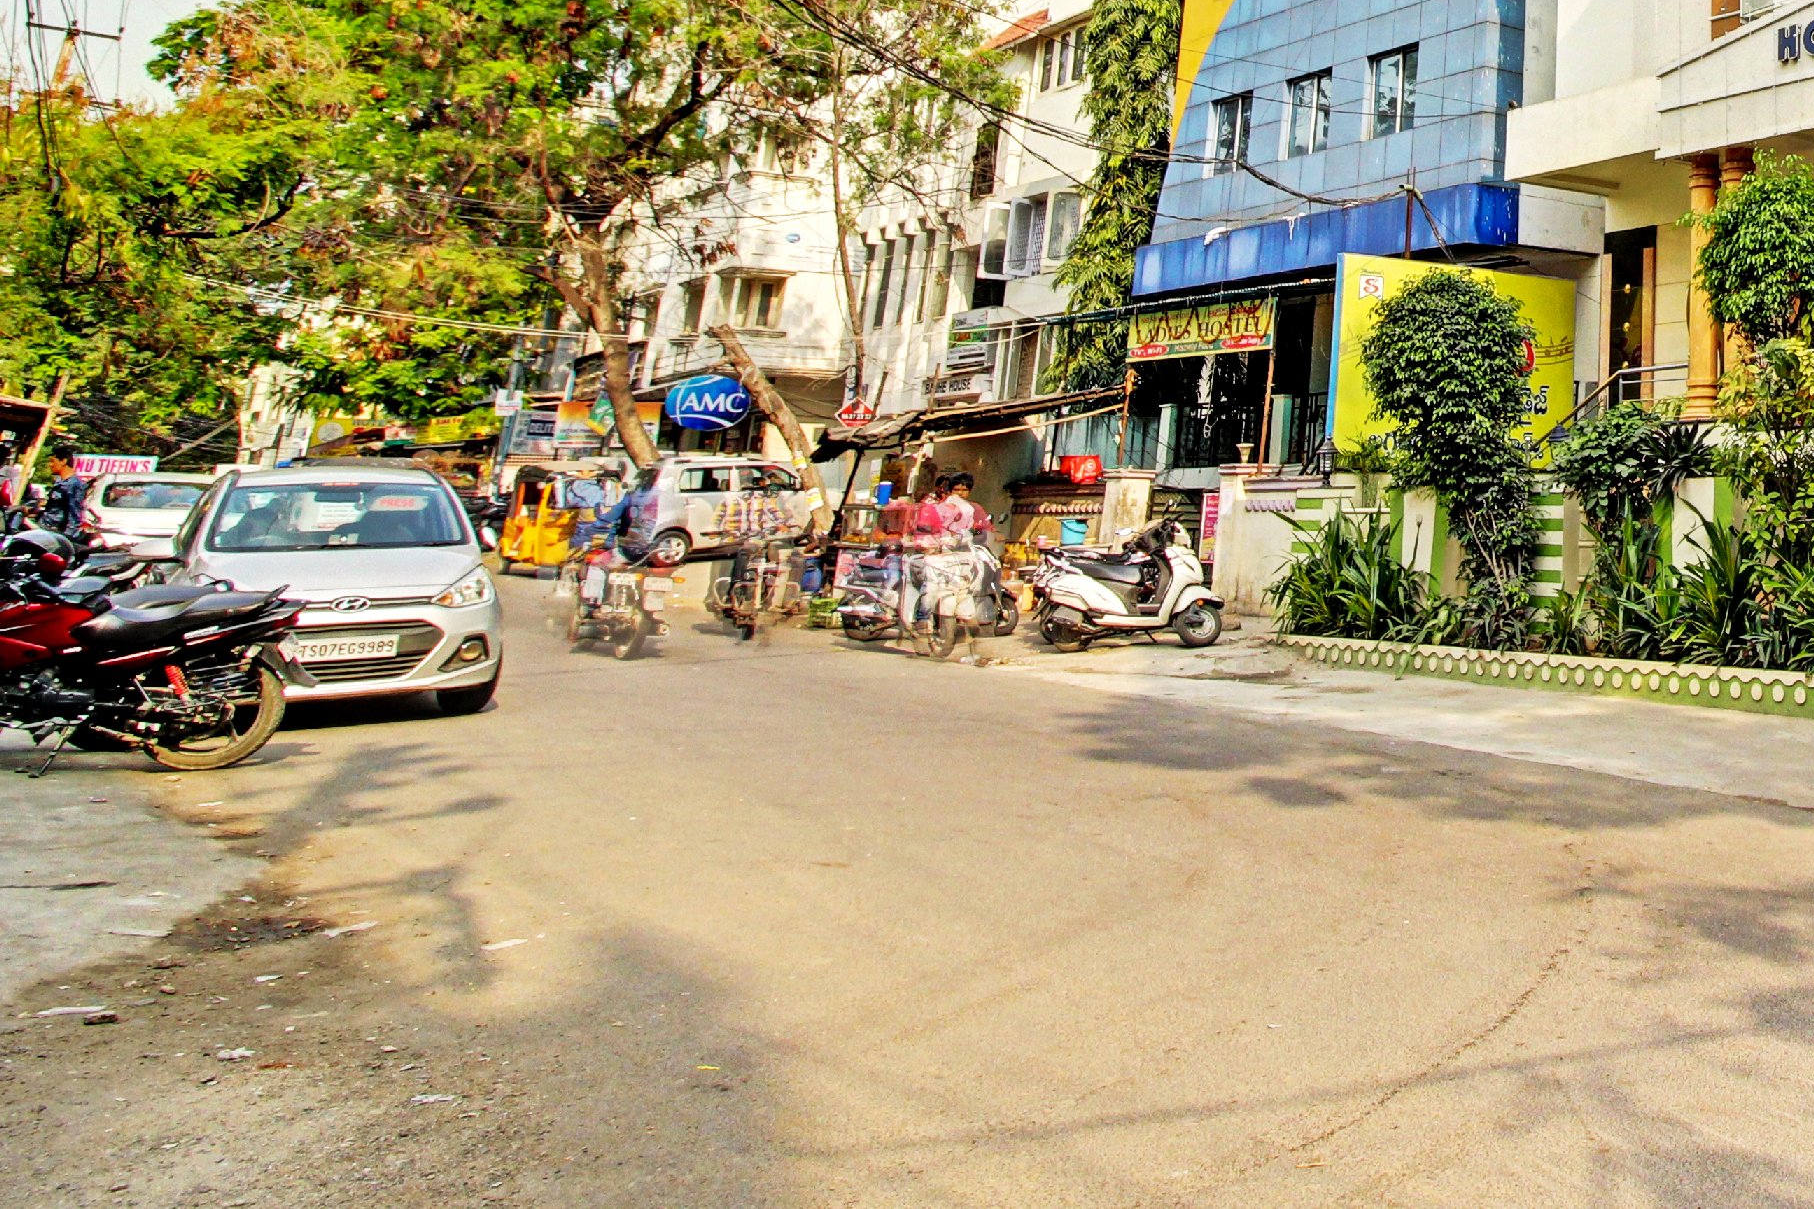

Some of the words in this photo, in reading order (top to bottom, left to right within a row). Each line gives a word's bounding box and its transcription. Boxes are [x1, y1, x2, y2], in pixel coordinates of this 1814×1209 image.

[948, 377, 971, 392] HOUSE
[681, 391, 746, 414] AMC
[99, 456, 151, 473] TIFFIN'S
[299, 639, 395, 659] TS07EG9989
